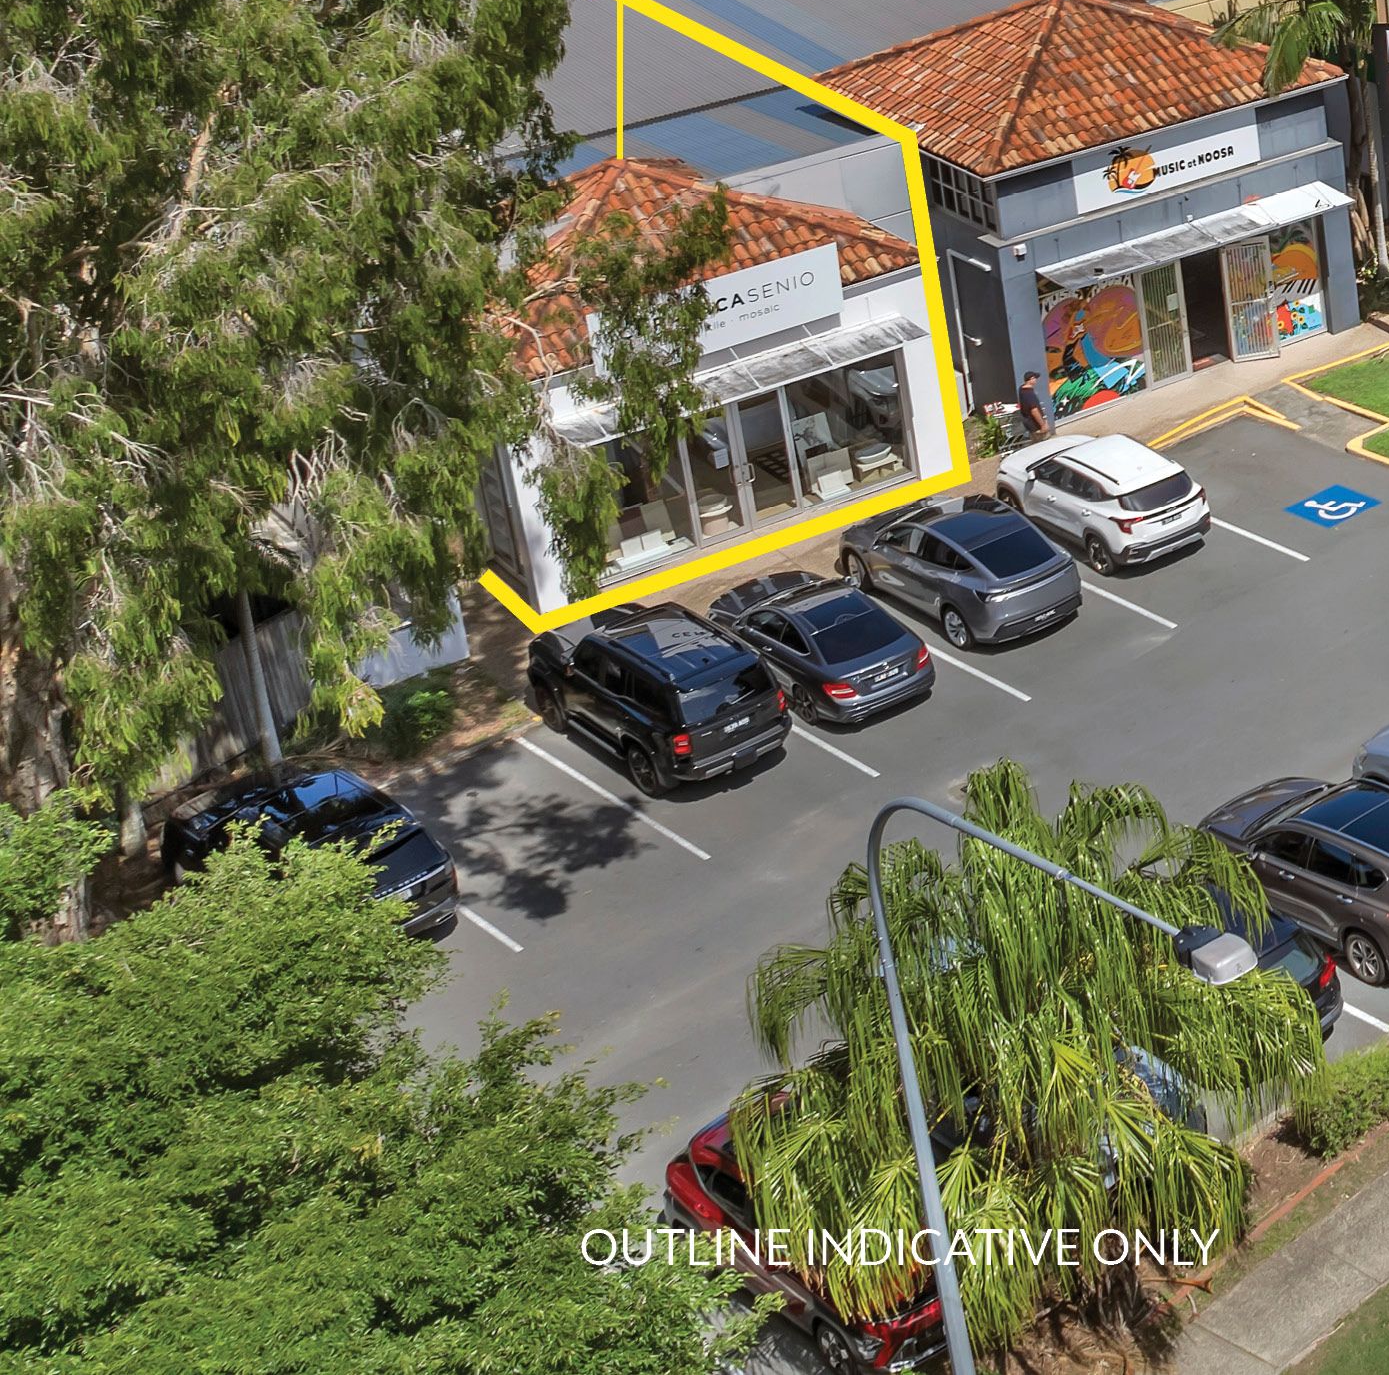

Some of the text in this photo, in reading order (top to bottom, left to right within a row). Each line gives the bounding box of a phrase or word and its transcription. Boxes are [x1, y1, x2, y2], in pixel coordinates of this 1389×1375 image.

[1152, 146, 1234, 177] MUSIC at NOOSA
[739, 304, 780, 322] mosaic
